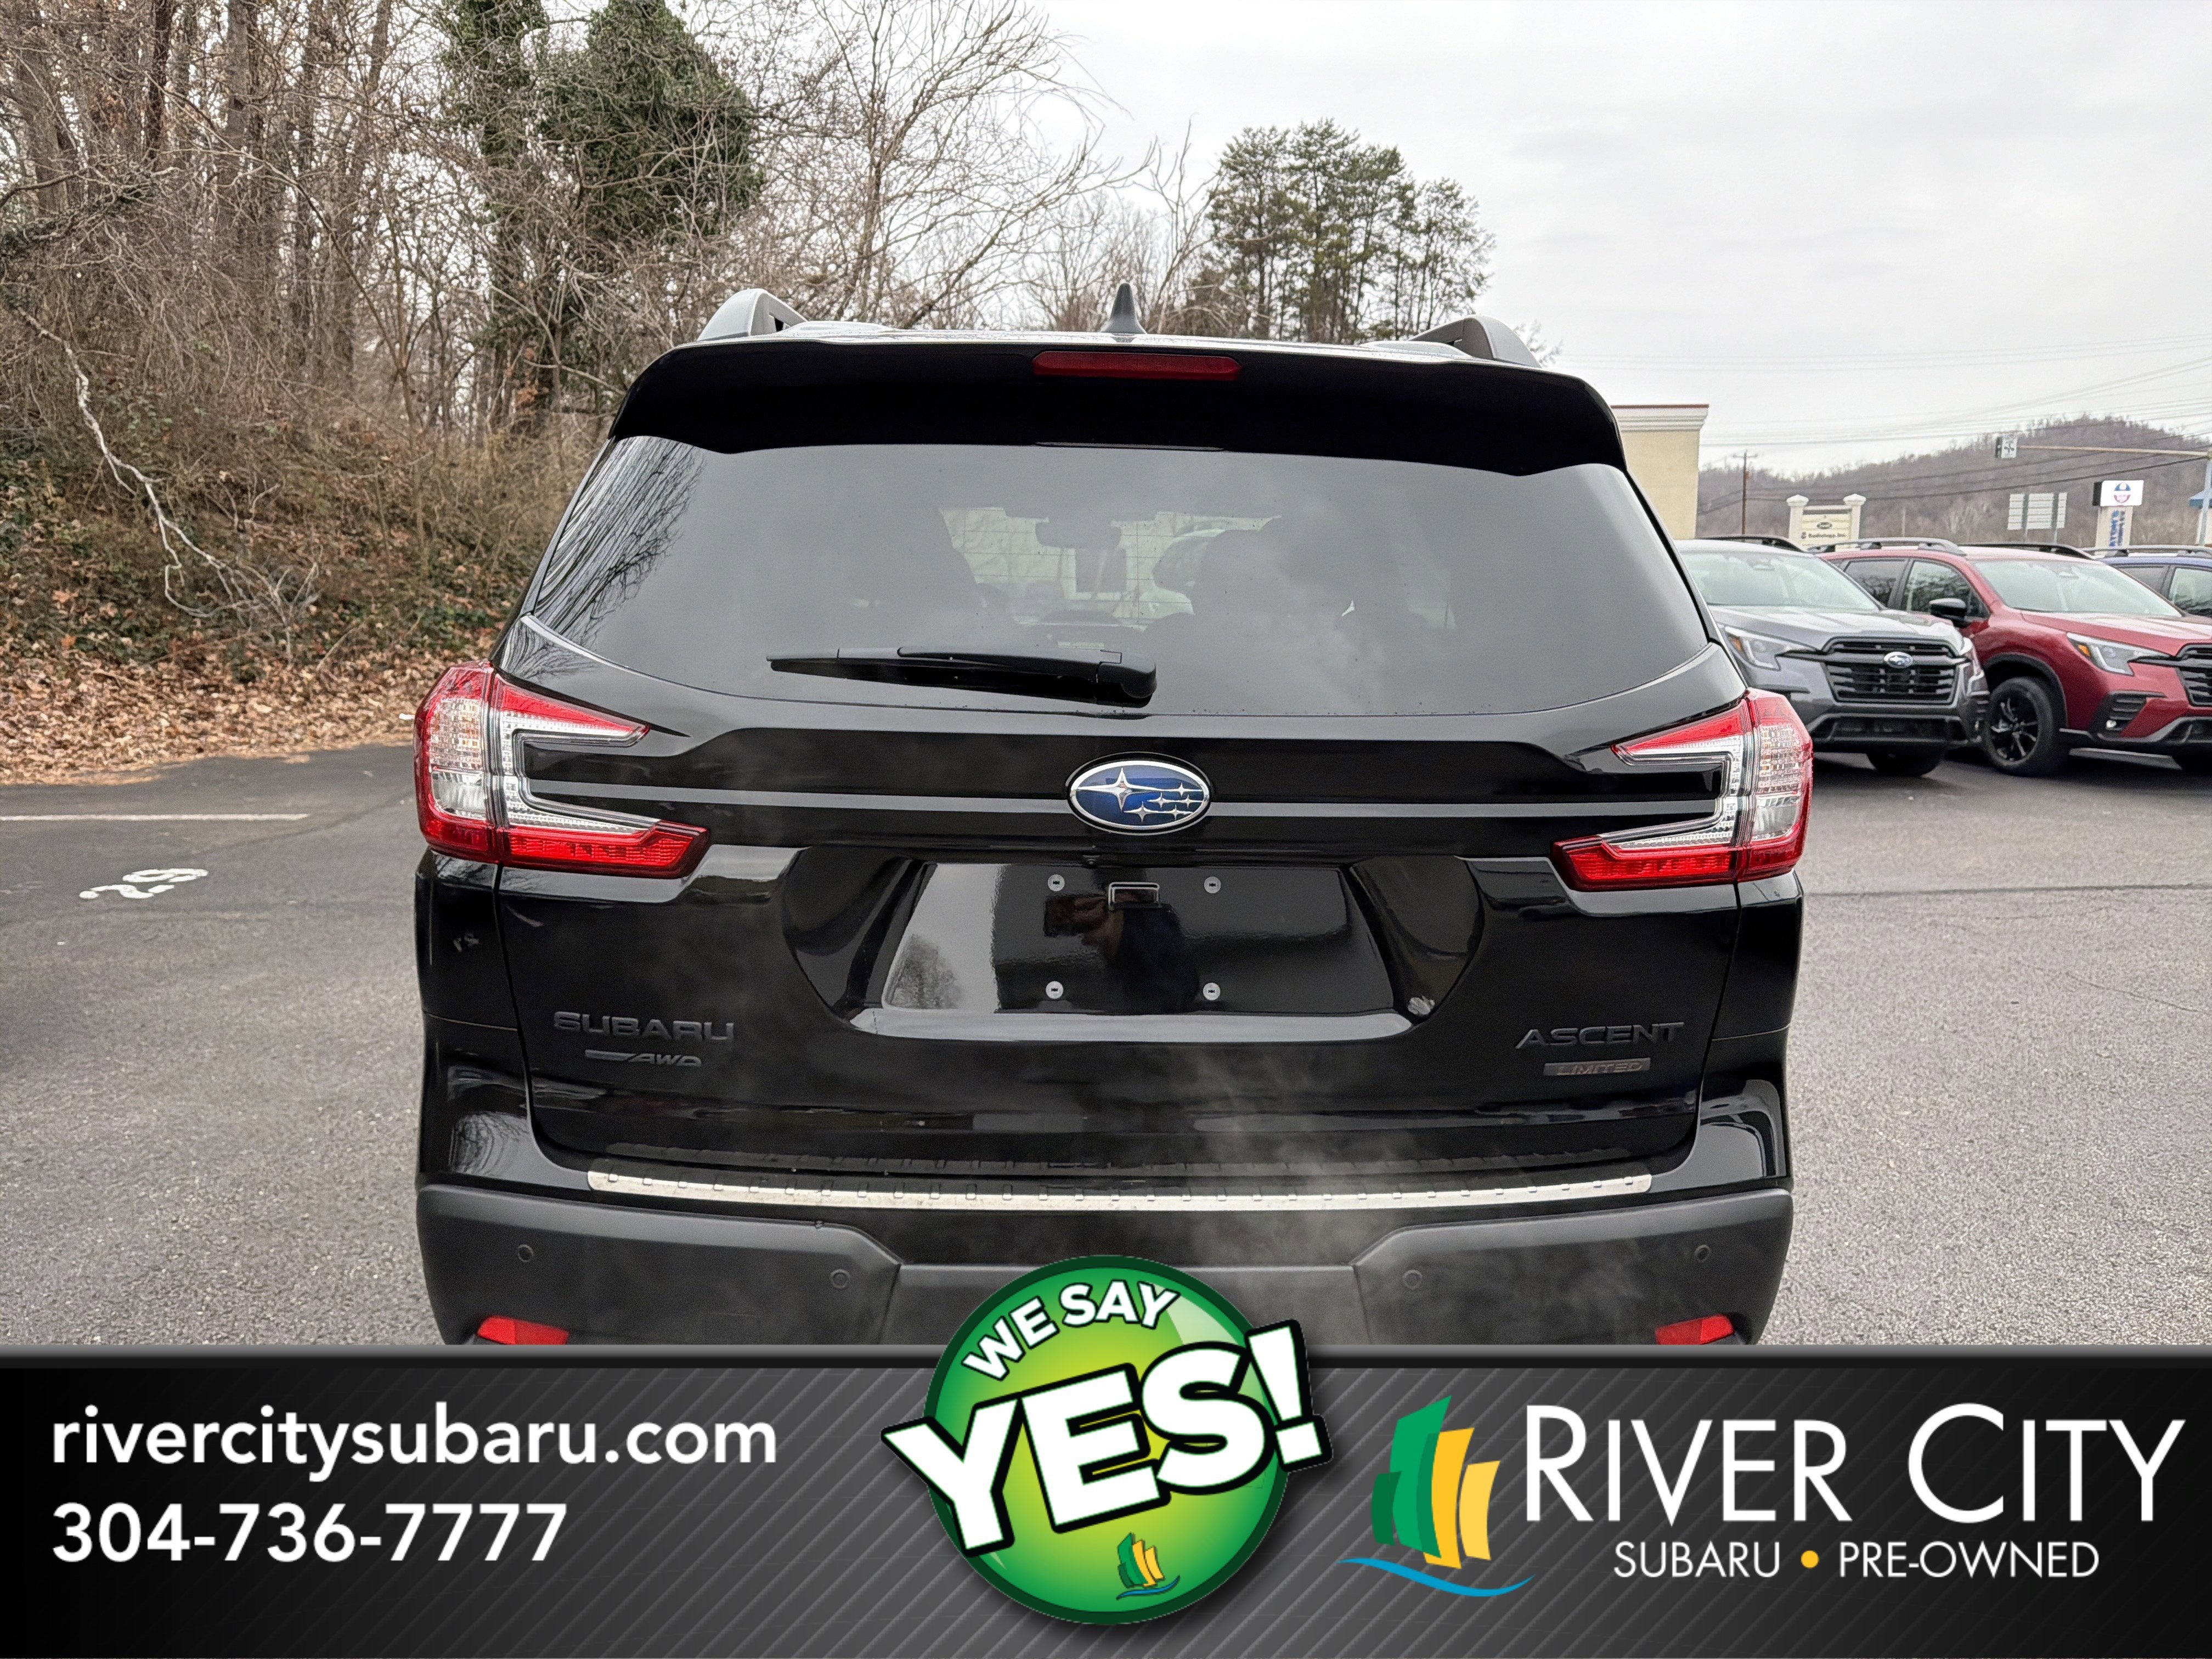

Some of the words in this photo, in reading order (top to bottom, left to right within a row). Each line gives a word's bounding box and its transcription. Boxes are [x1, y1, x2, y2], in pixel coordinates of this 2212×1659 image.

[553, 1011, 735, 1042] SUBARU
[1515, 1022, 1685, 1049] ASCENT
[628, 1053, 702, 1068] AWD
[1556, 1061, 1644, 1076] LIMITED
